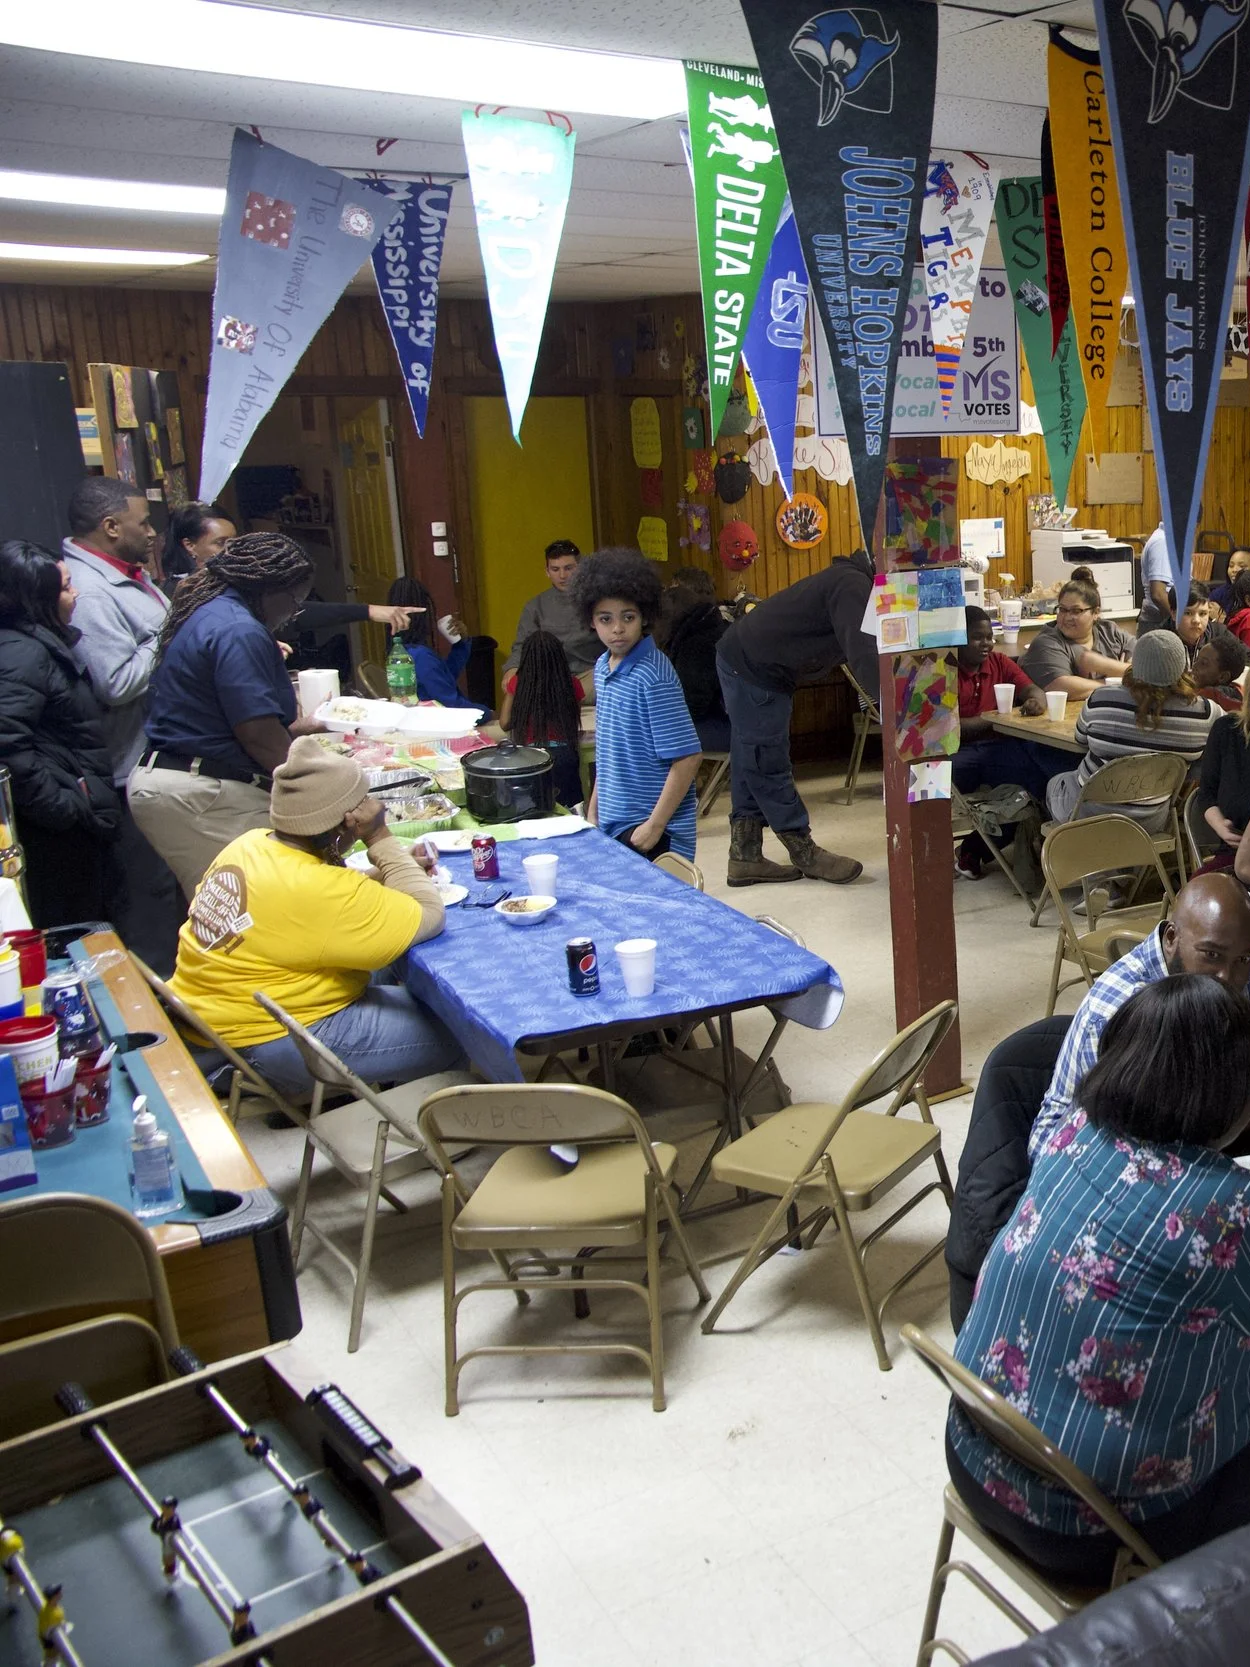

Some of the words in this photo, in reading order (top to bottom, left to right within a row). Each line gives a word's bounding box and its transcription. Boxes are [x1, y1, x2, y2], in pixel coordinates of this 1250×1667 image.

[746, 73, 764, 88] MIS
[968, 177, 981, 201] 1909
[1083, 69, 1112, 233] Carleton
[306, 177, 343, 226] The
[714, 173, 766, 276] DELTA
[839, 145, 917, 277] JOHNS
[1165, 150, 1194, 281] BLUE
[1198, 213, 1207, 269] JOHNS
[273, 235, 326, 316] University
[381, 180, 413, 328] Mssissippi
[408, 189, 449, 348] University
[921, 226, 954, 323] TIGERS
[979, 276, 1006, 298] to
[714, 290, 745, 386] STATE
[812, 233, 857, 370] UNIVERSITY
[1084, 244, 1114, 382] College
[1198, 274, 1207, 350] HOPKINS
[408, 362, 430, 397] of
[851, 286, 900, 456] HOPKINS
[962, 368, 1011, 400] MS
[972, 336, 1006, 358] 5th
[1165, 293, 1194, 412] JAYS
[220, 365, 275, 450] Alabama
[964, 403, 1011, 416] VOTES
